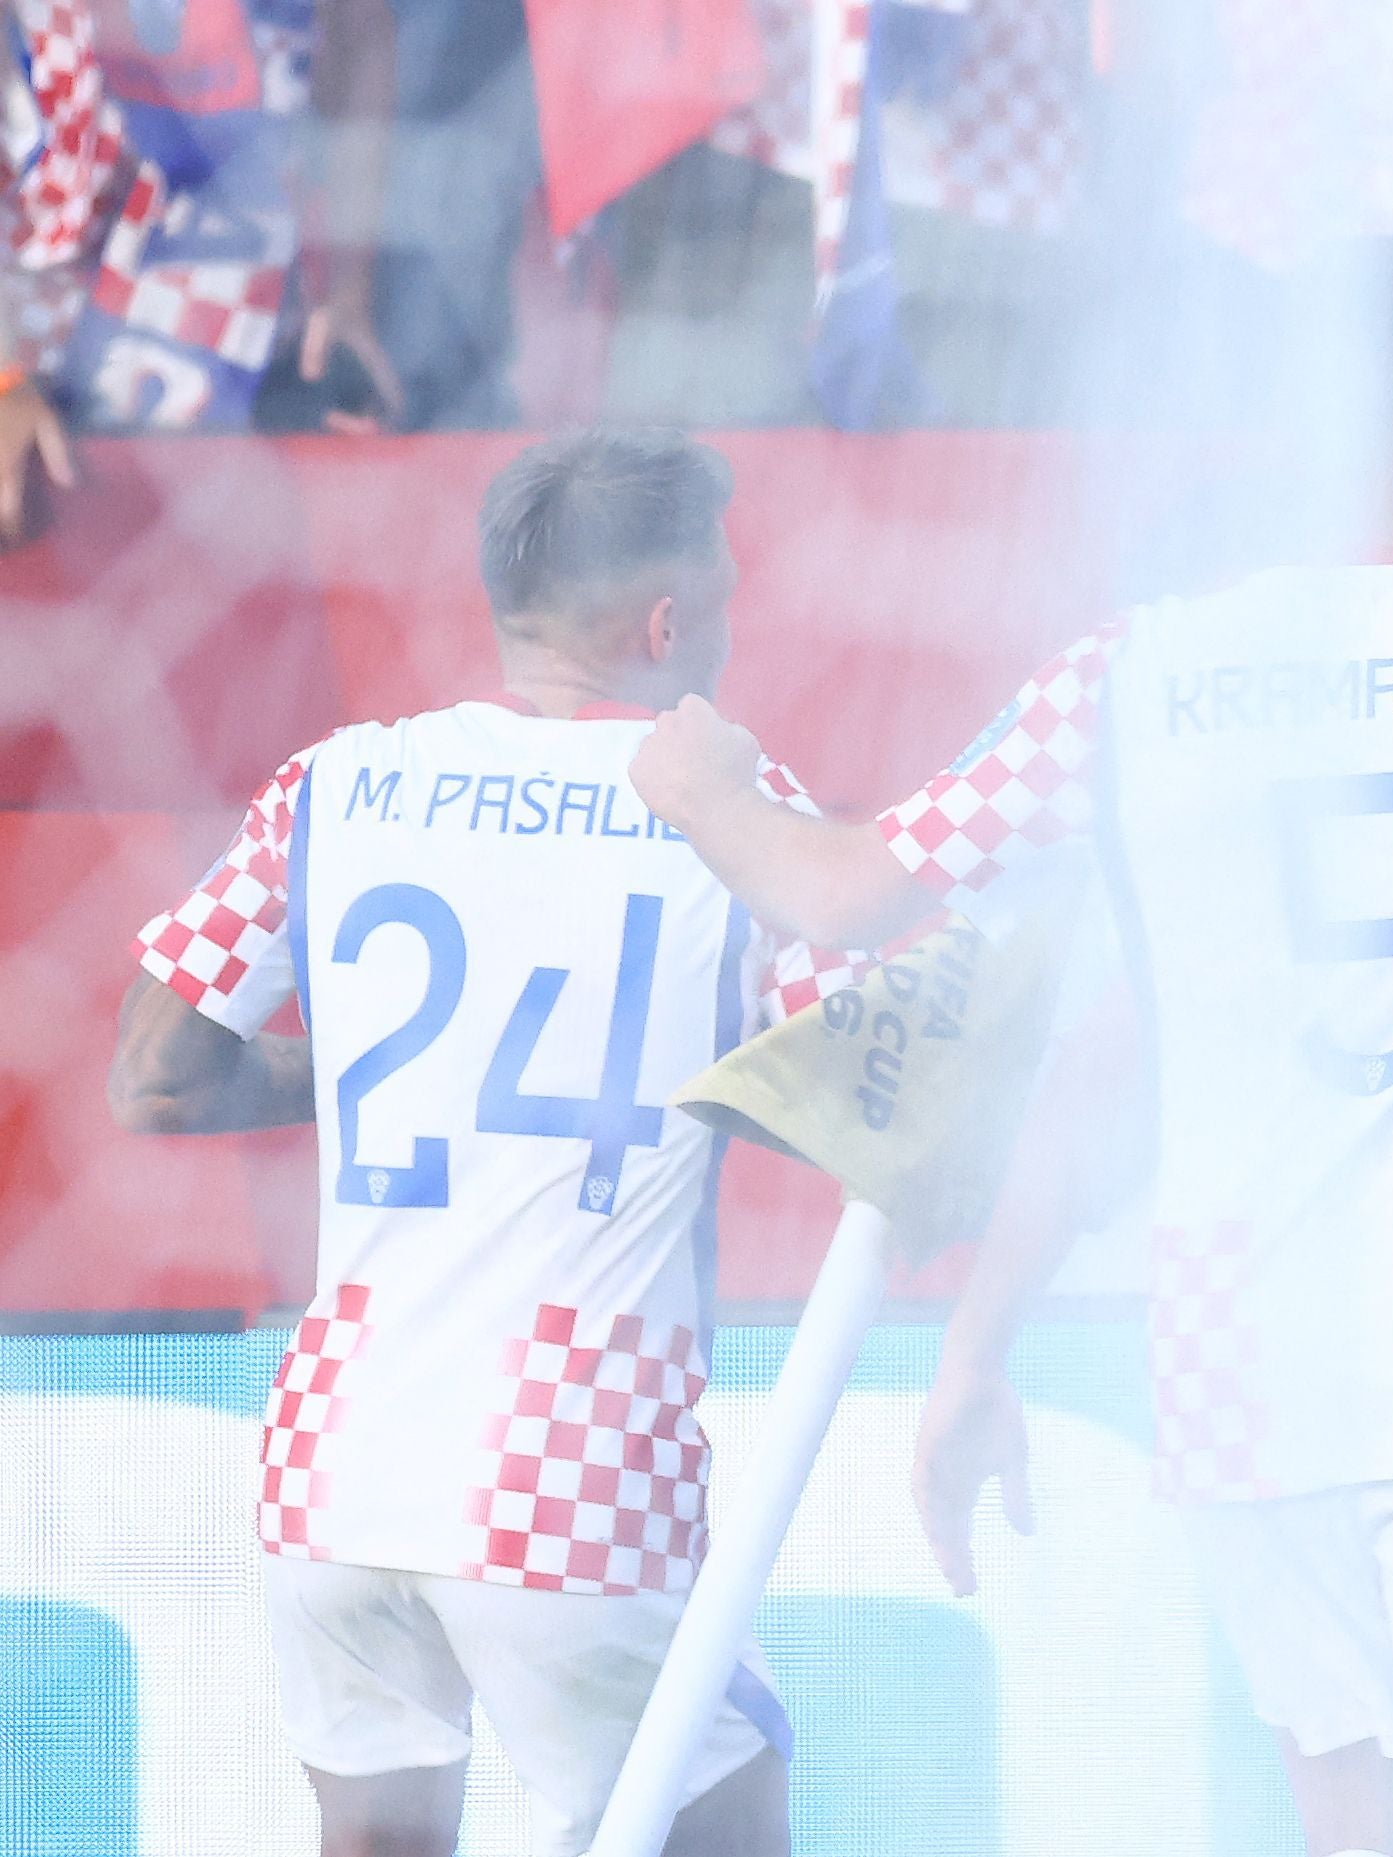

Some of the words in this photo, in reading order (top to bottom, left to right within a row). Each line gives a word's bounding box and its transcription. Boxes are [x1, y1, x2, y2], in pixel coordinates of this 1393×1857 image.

[344, 766, 402, 822] M.
[331, 882, 665, 1217] 24
[854, 1009, 908, 1132] CUP
